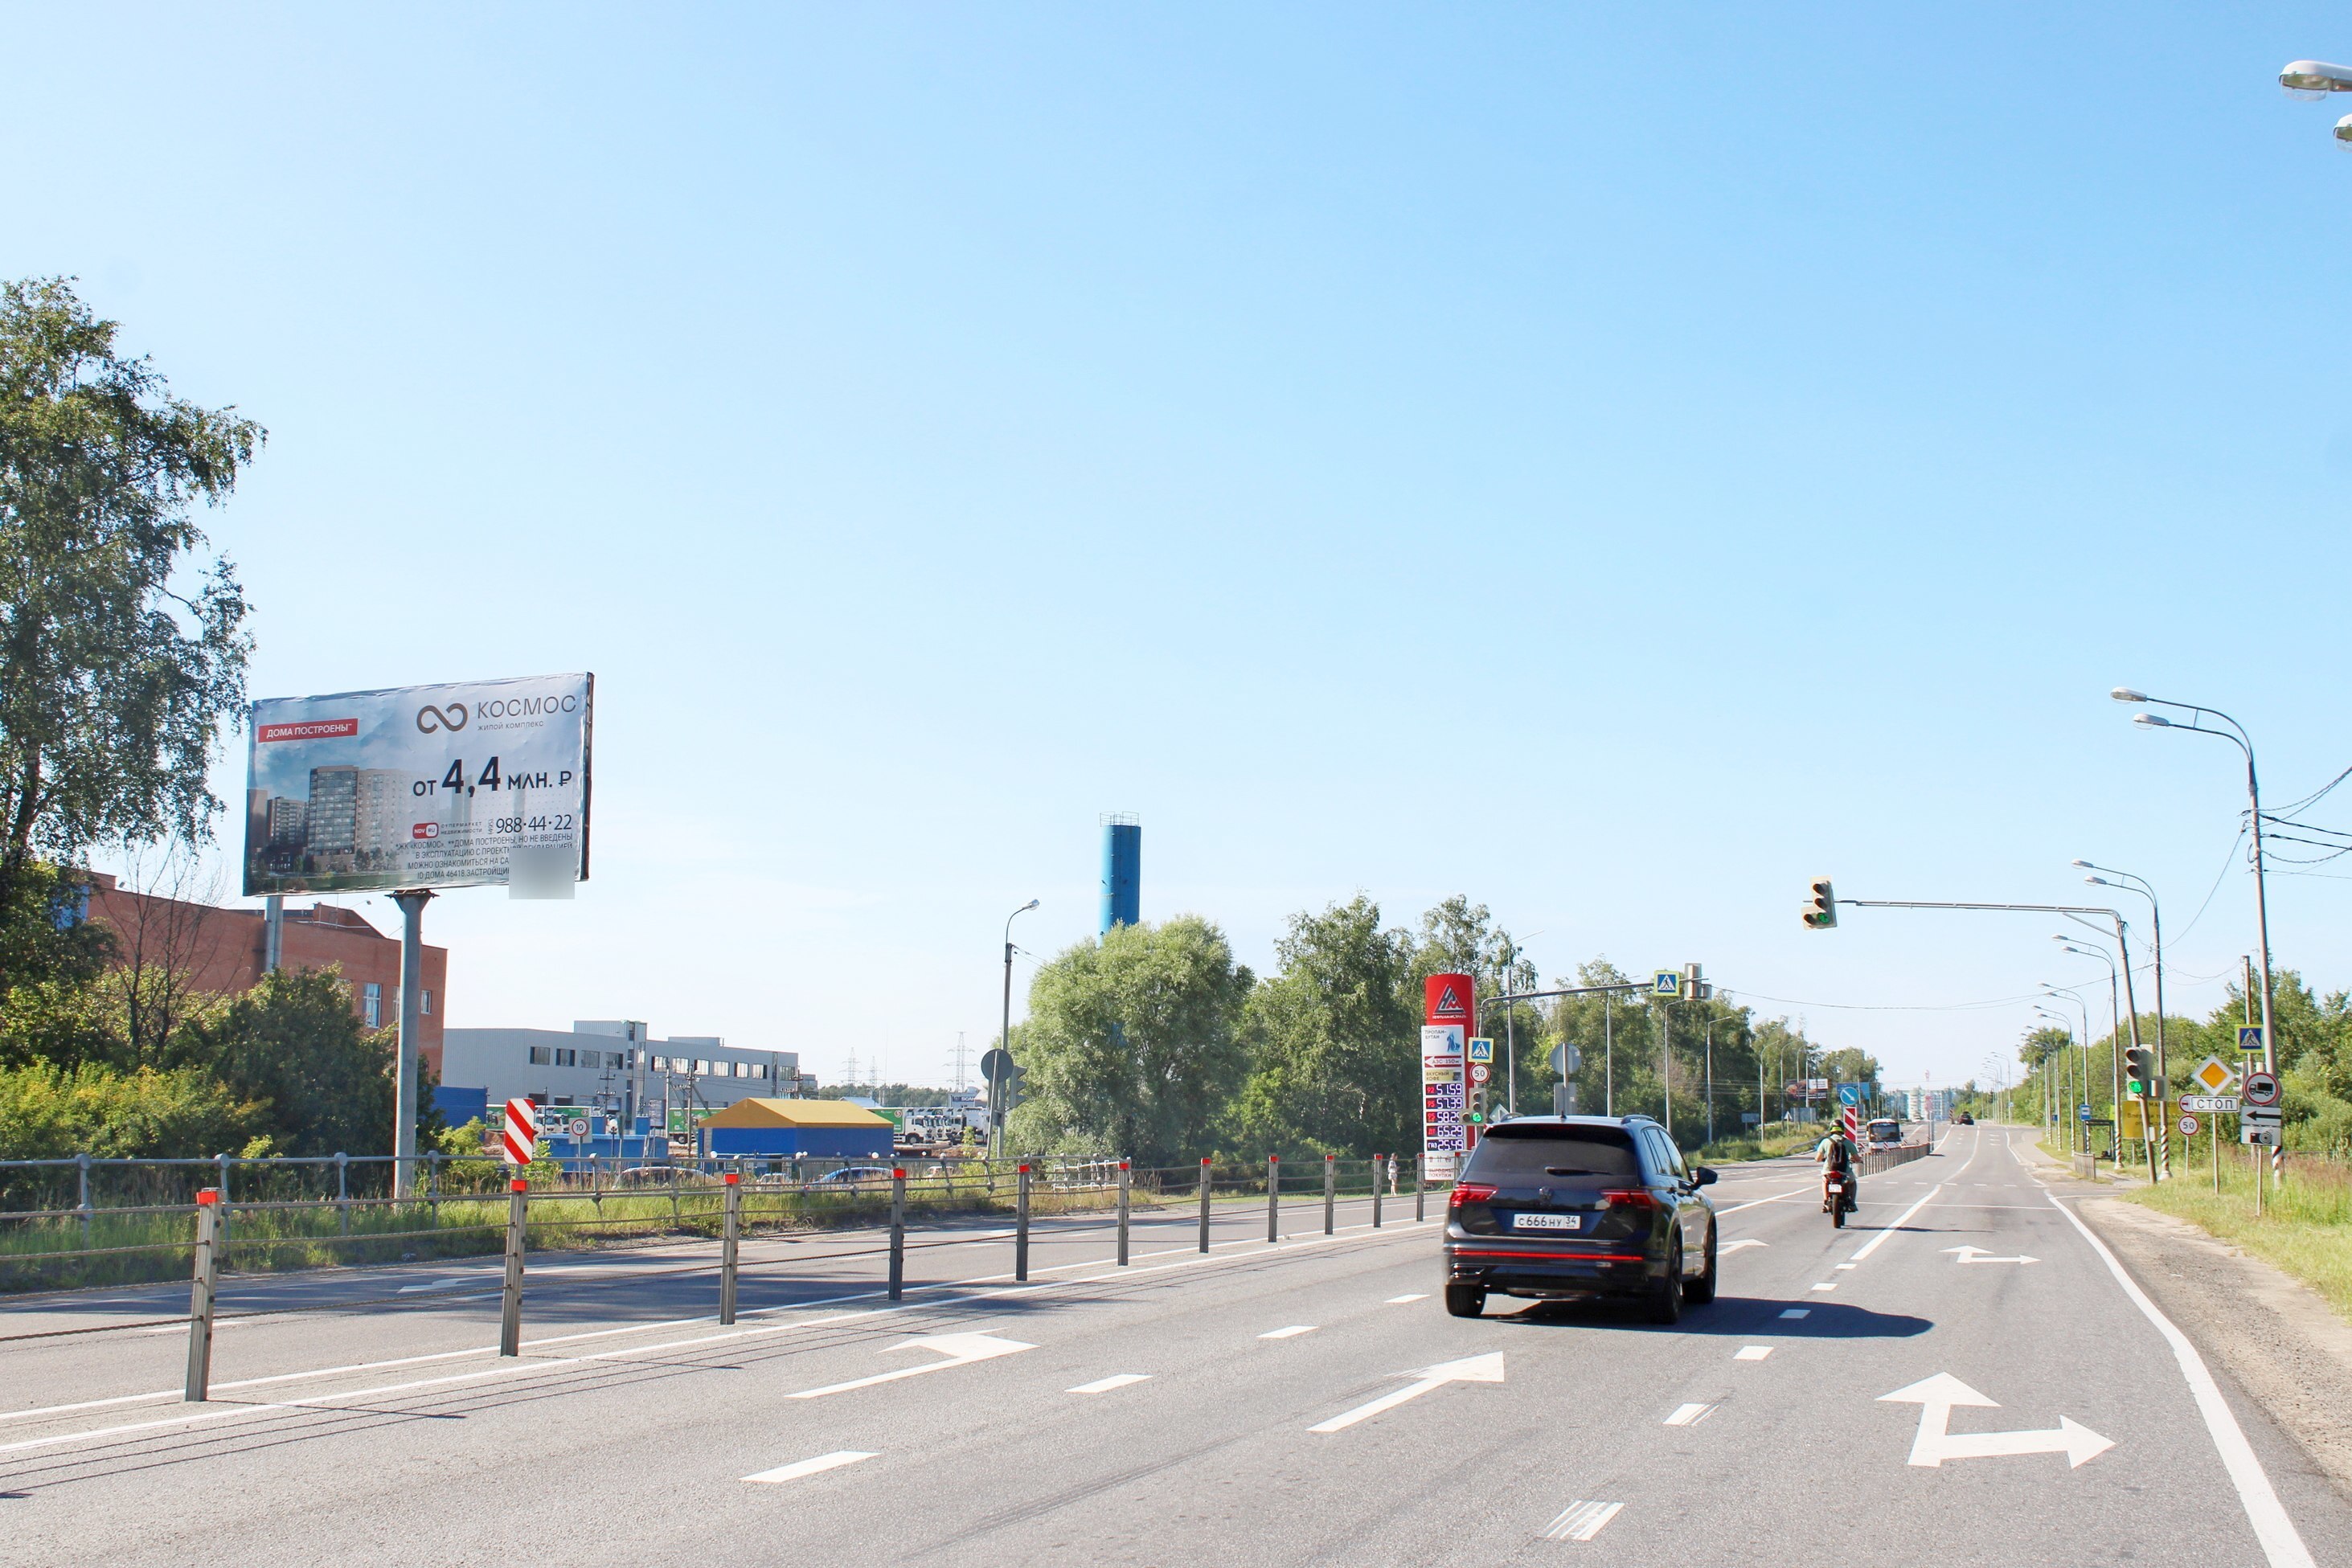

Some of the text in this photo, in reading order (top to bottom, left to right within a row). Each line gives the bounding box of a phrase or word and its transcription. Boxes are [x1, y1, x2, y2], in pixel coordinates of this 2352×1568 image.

[477, 695, 576, 718] КОСМОС
[477, 720, 544, 731] жилой комплекс
[266, 727, 293, 739] ДОМА
[441, 756, 501, 797] 4,4
[508, 772, 553, 790] МЛН.
[518, 835, 528, 843] НО
[530, 834, 539, 842] НЕ
[540, 833, 572, 842] ВВЕДЕНЫ
[421, 848, 475, 858] ЭКСПЛУАТАЦИЮ
[408, 861, 433, 870] МОЖНО
[435, 858, 488, 868] ОЗНАКОМИТЬСЯ
[425, 870, 445, 880] ДОМА
[2197, 1099, 2233, 1109] СТОП
[2182, 1121, 2194, 1130] 50
